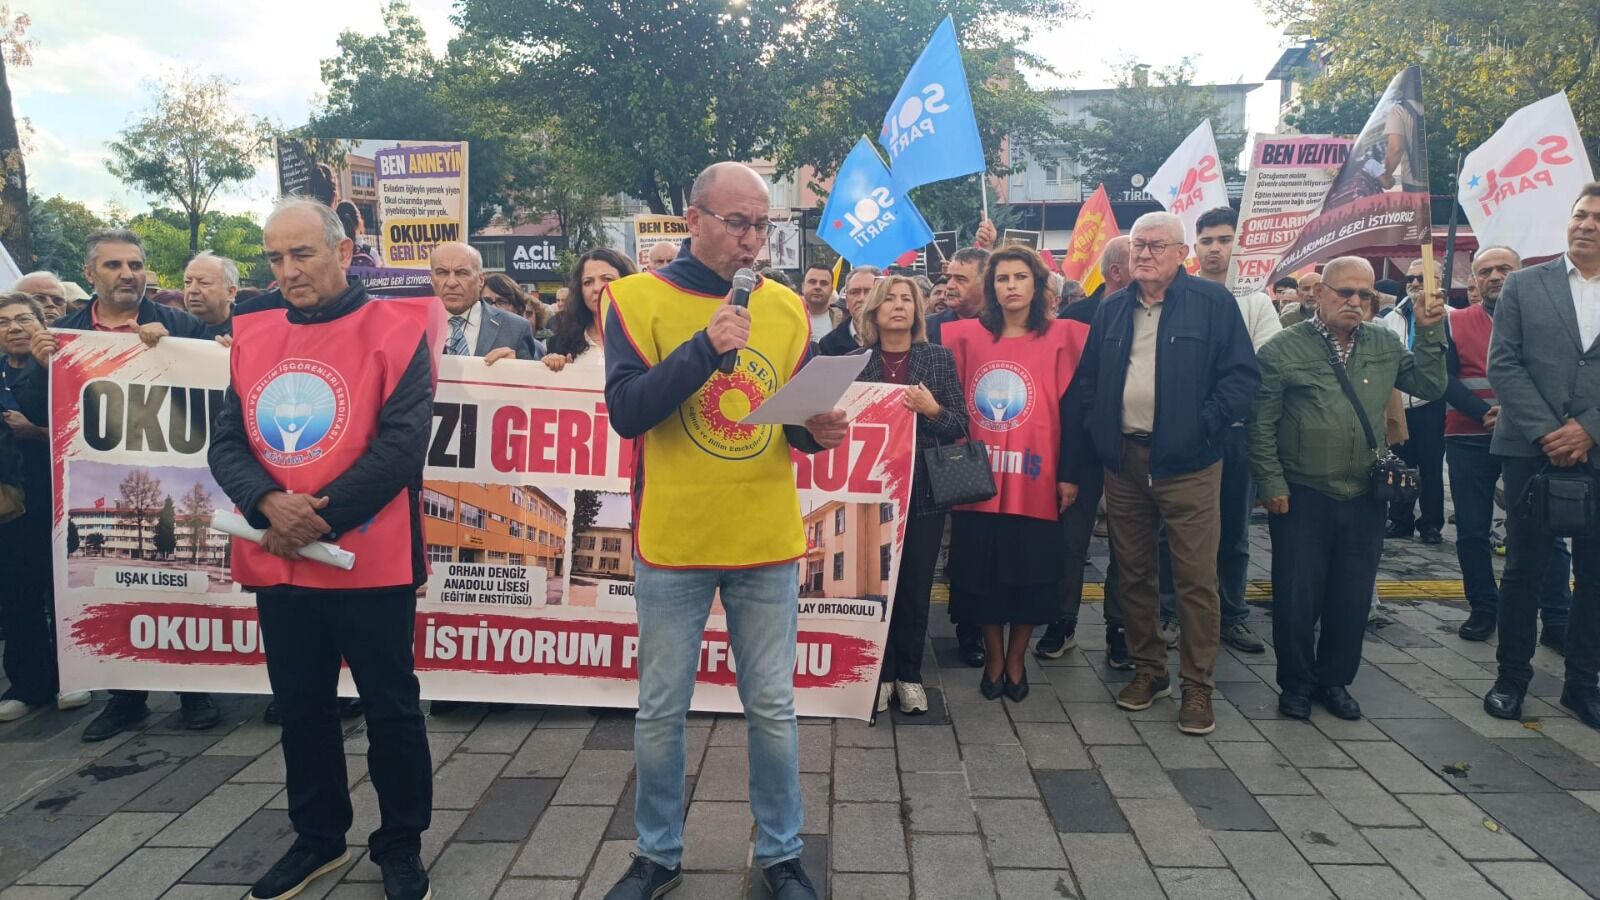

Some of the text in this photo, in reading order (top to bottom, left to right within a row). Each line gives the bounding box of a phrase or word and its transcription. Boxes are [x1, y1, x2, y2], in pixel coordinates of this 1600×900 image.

[1261, 143, 1295, 165] BEN
[380, 154, 406, 176] BEN
[639, 222, 661, 234] BEN
[1248, 215, 1309, 232] OKULLARI
[1338, 217, 1365, 238] GERİ
[1368, 210, 1415, 228] İSTİYORUZ
[1245, 231, 1270, 246] GERİ
[390, 242, 415, 262] GERİ
[513, 241, 557, 261] ACİL
[249, 394, 258, 405] VE
[257, 370, 279, 393] BİLİM
[279, 362, 338, 387] İŞGÖRENLERİ
[328, 387, 347, 441] SENDİKASI
[490, 402, 609, 477] GERİ
[115, 571, 188, 588] UŞAK LİSESİ
[448, 565, 527, 580] ORHAN DENGİZ
[443, 578, 530, 593] ANADOLU LİSESİ
[608, 582, 635, 596] ENDÜ
[440, 590, 533, 607] (EĞİTİM ENSTİTÜSÜ)
[797, 602, 875, 617] LAY ORTAOKULU
[129, 614, 266, 654] OKULU
[424, 618, 613, 668] İSTİYORUM
